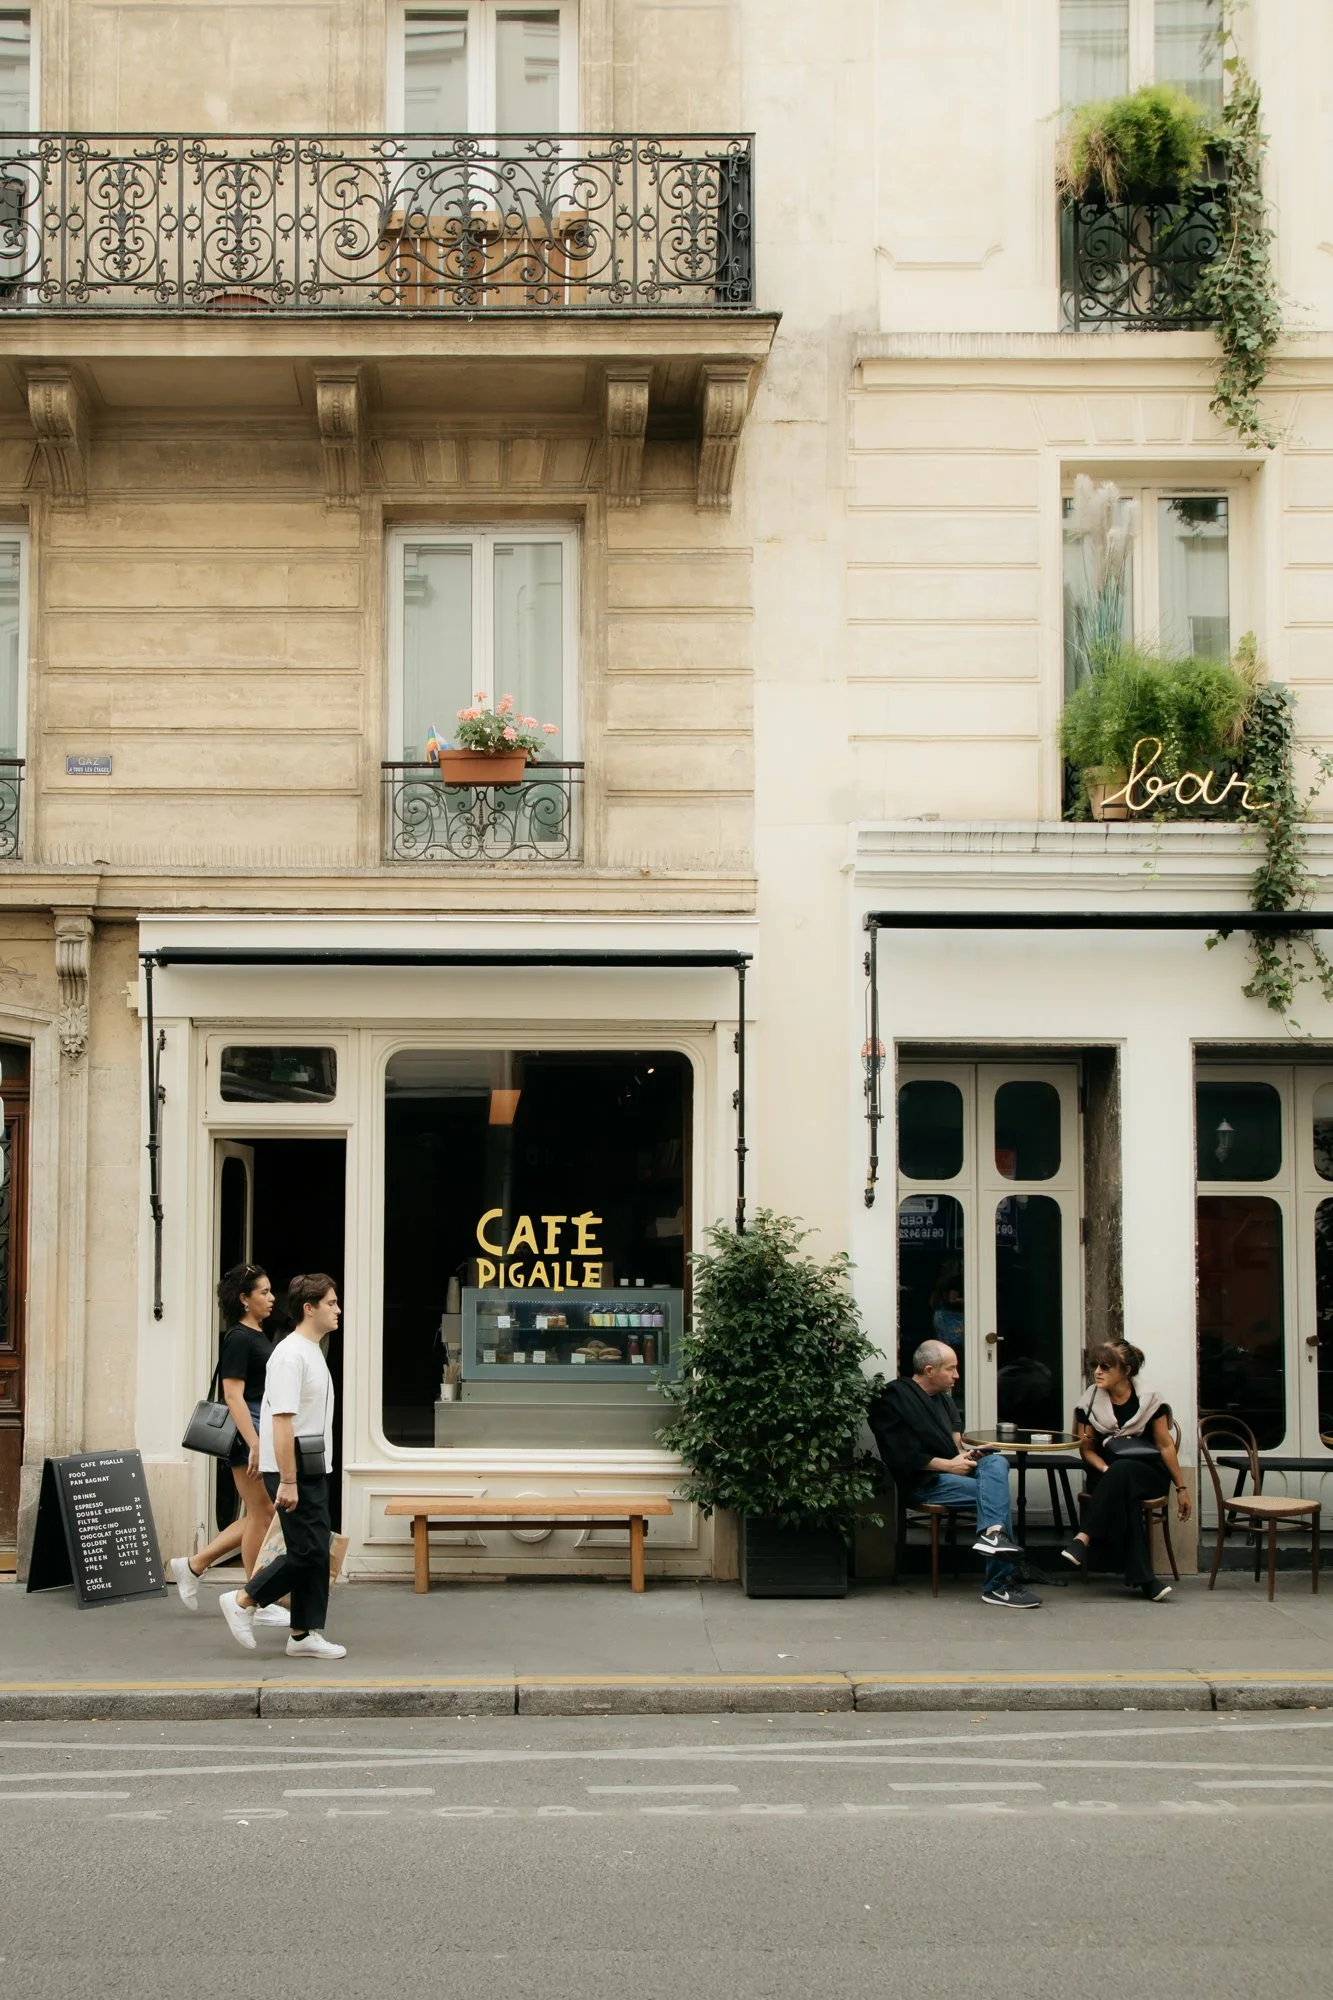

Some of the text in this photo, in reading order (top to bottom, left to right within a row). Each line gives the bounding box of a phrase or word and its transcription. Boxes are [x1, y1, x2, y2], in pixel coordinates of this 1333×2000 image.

[78, 757, 100, 766] GAZ
[1100, 737, 1273, 811] bar
[476, 1208, 603, 1257] CAFÉ
[476, 1258, 603, 1292] PIGALLE
[100, 1458, 124, 1466] PIGALLE
[85, 1476, 109, 1484] BAGNAT
[75, 1502, 103, 1510] ESPRESSO
[76, 1510, 102, 1518] DOUBLE
[105, 1506, 132, 1514] ESPRESSO
[79, 1522, 119, 1533] CAPPUCCINO
[80, 1531, 111, 1540] CHOCOLAT
[115, 1527, 136, 1535] CHAUD
[82, 1540, 107, 1548] GOLDEN
[115, 1535, 136, 1543] LATTE
[83, 1548, 103, 1556] BLACK
[117, 1542, 137, 1550] LATTE
[84, 1555, 108, 1563] GREEN
[119, 1550, 139, 1558] LATTE
[87, 1583, 112, 1591] COOKIE
